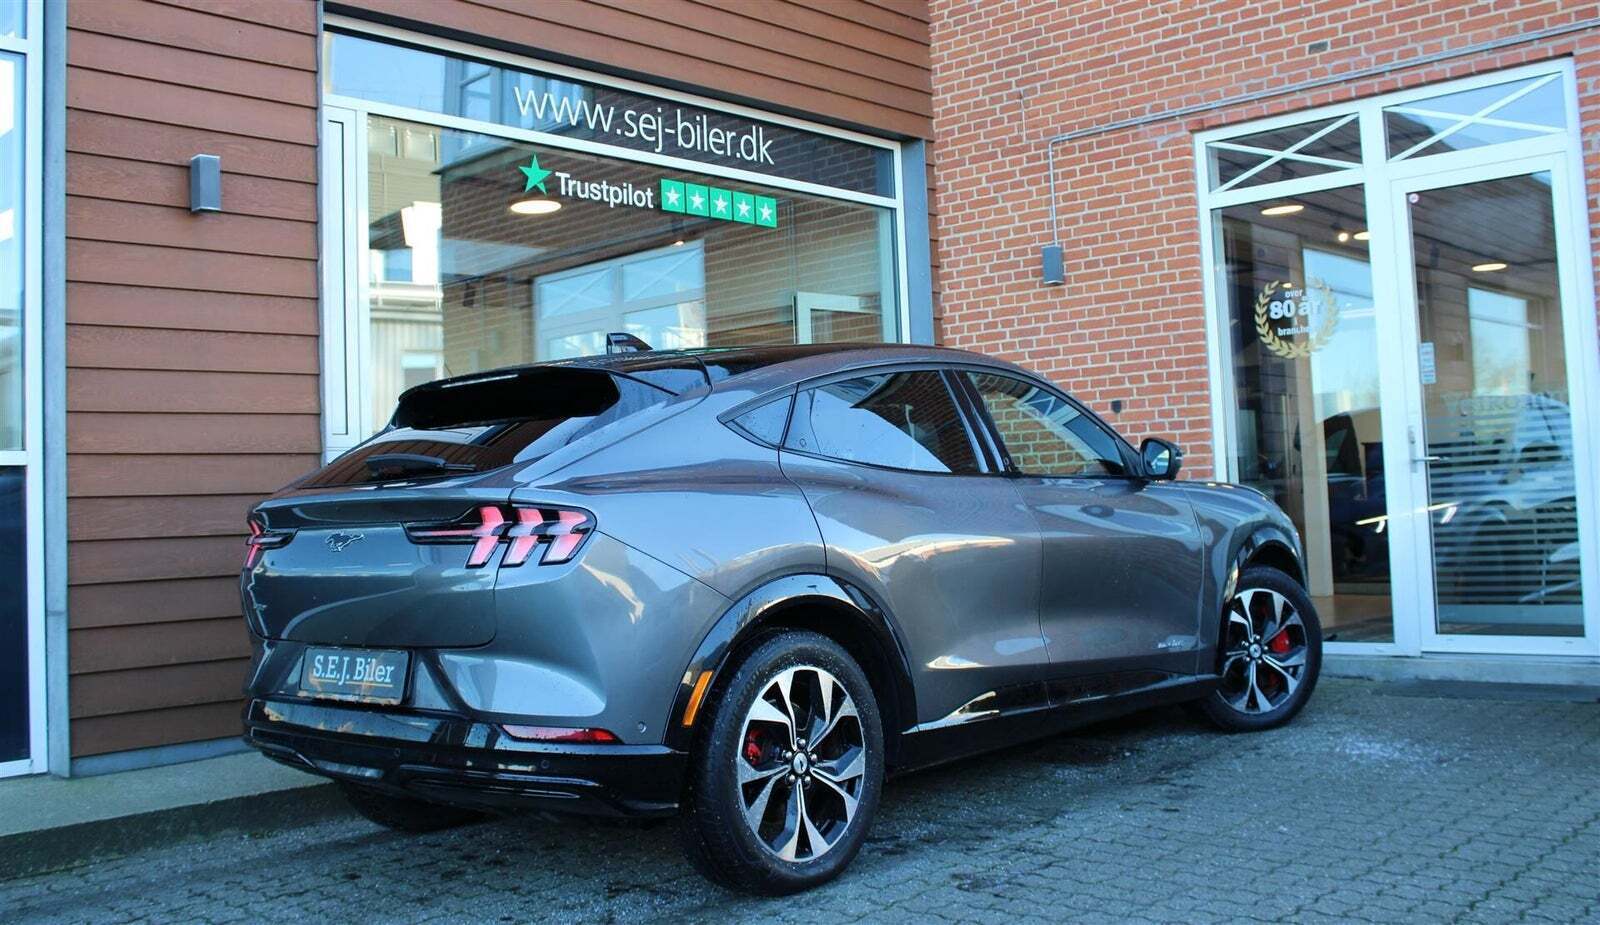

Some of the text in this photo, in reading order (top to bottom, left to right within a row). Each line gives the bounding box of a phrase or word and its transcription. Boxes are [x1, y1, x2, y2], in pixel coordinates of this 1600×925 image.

[514, 86, 775, 166] www.sej-biler.dk
[555, 171, 655, 209] Trustpilot
[1284, 289, 1303, 299] over
[1269, 300, 1296, 320] 80
[313, 655, 395, 685] S.E.J. Biler
